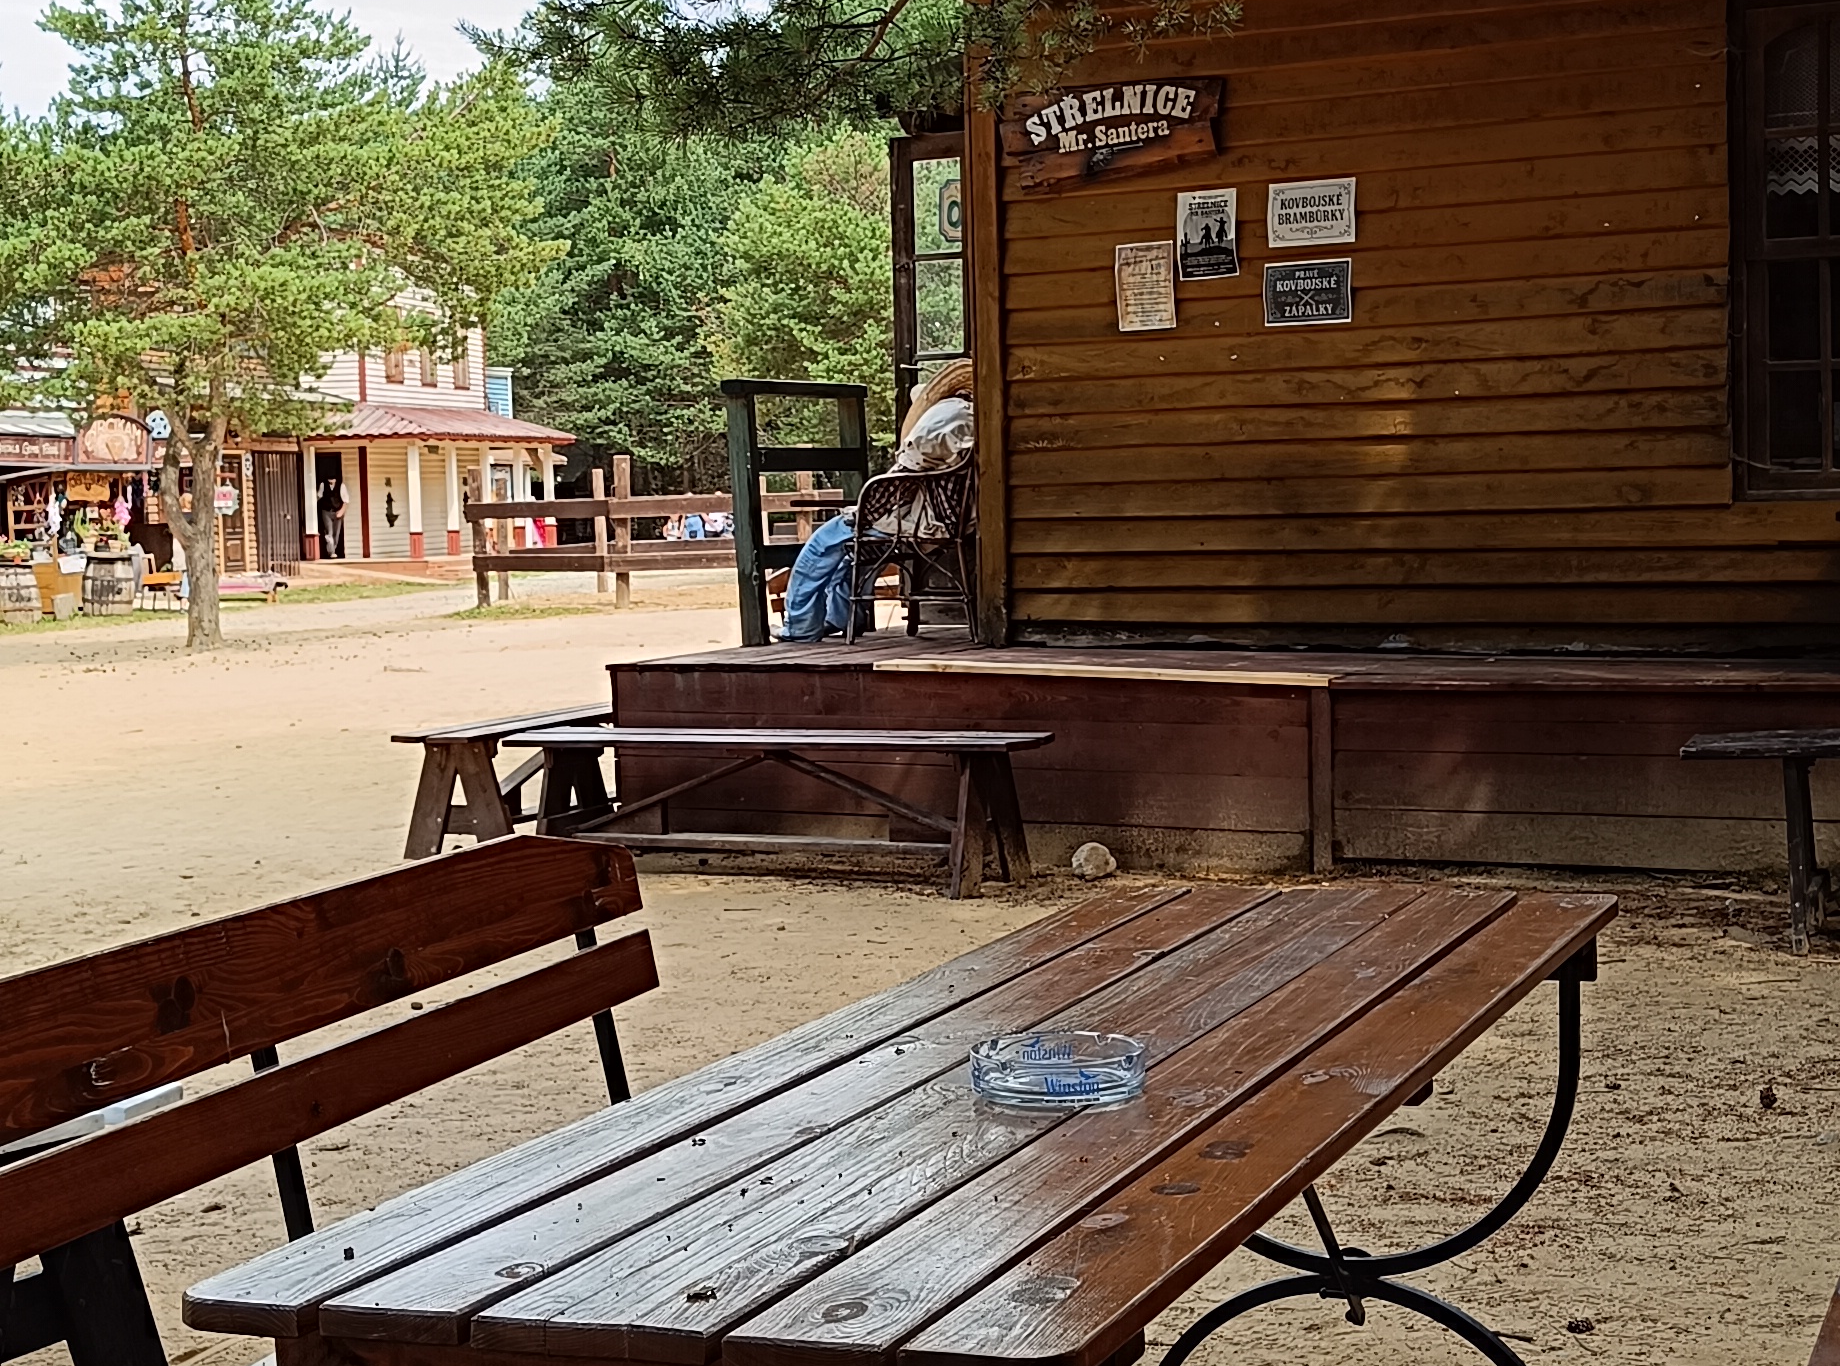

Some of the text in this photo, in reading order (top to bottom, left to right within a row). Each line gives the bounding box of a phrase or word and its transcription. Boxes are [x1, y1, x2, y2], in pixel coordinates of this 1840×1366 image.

[1025, 85, 1196, 146] STŘELNICE
[1058, 120, 1170, 153] Mr. Santera
[1280, 192, 1343, 211] KOVBOJSKÉ
[1276, 275, 1338, 291] KOVBOJSKÉ
[1295, 269, 1319, 278] PRAVÉ
[1284, 304, 1333, 316] ZÁPALKY
[1044, 1076, 1100, 1095] Winston
